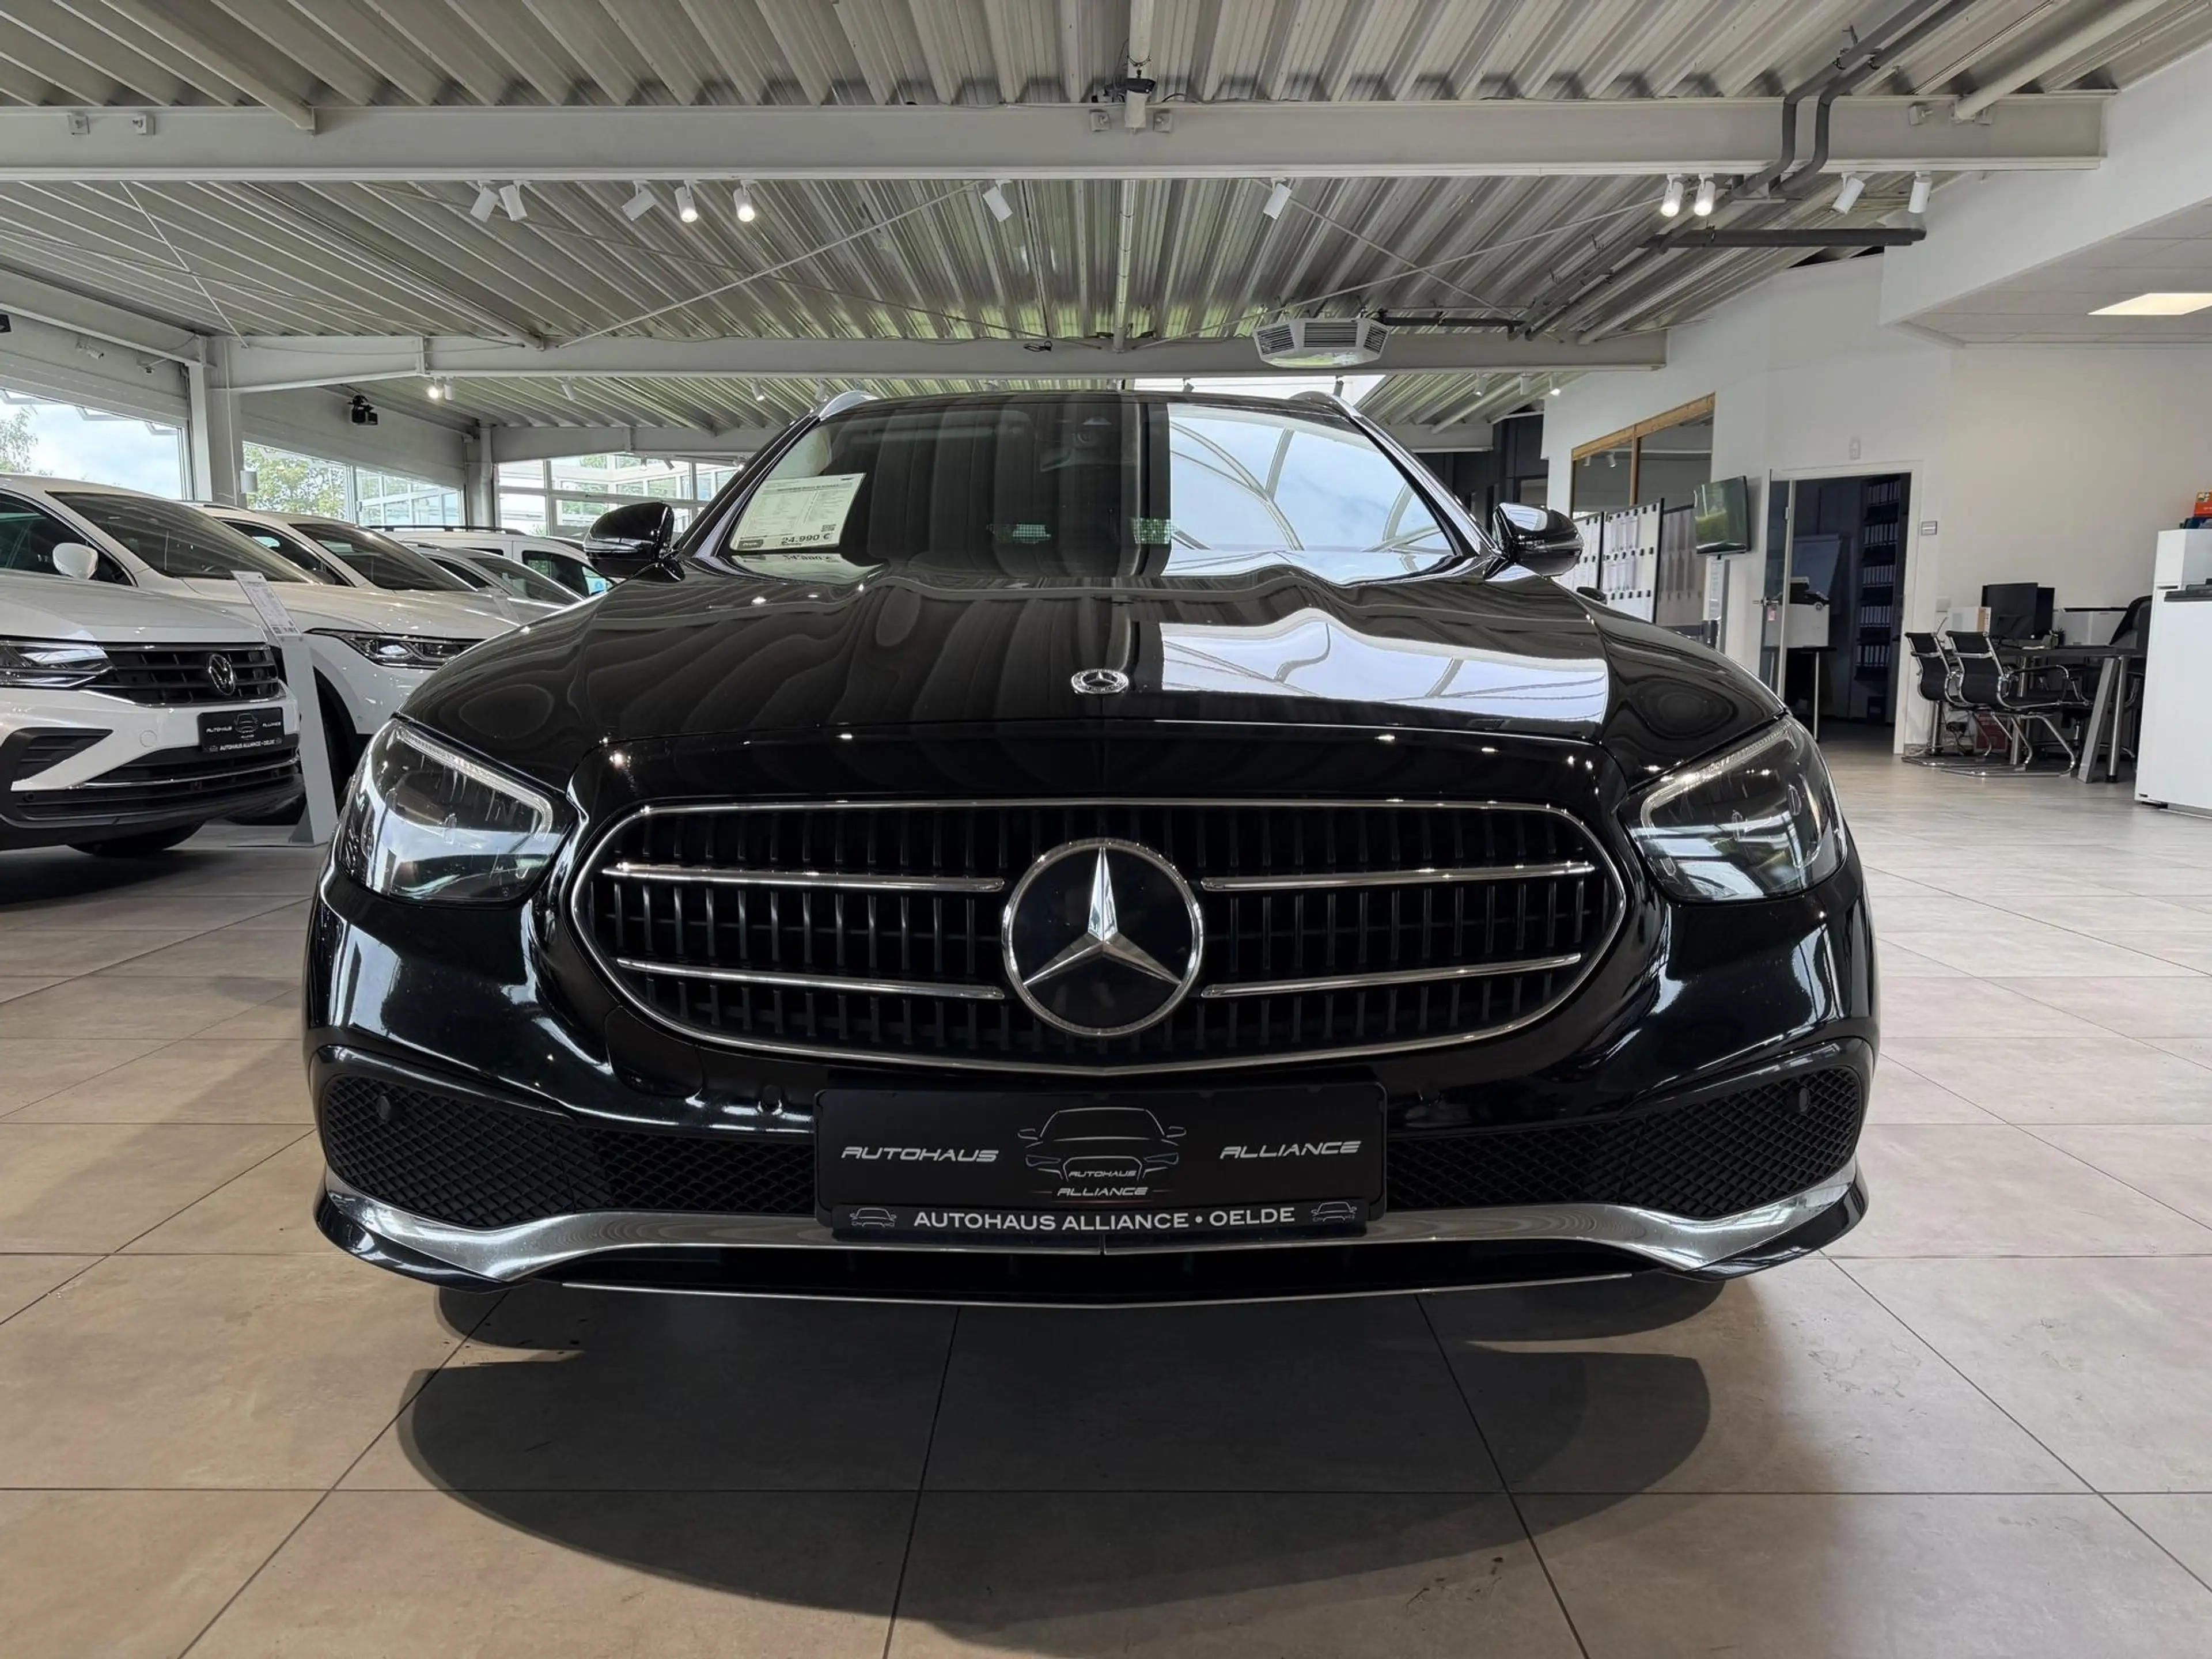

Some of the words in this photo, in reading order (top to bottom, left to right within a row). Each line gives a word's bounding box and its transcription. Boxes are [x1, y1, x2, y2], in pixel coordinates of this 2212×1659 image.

[782, 534, 820, 544] 24.990
[841, 1146, 999, 1162] AUTOHAUS
[1220, 1141, 1362, 1160] ALLIANCE
[1057, 1187, 1149, 1196] ALLIANCE
[914, 1211, 1056, 1230] AUTOHAUS
[1061, 1213, 1190, 1230] ALLIANCE
[1209, 1207, 1295, 1226] OELDE
